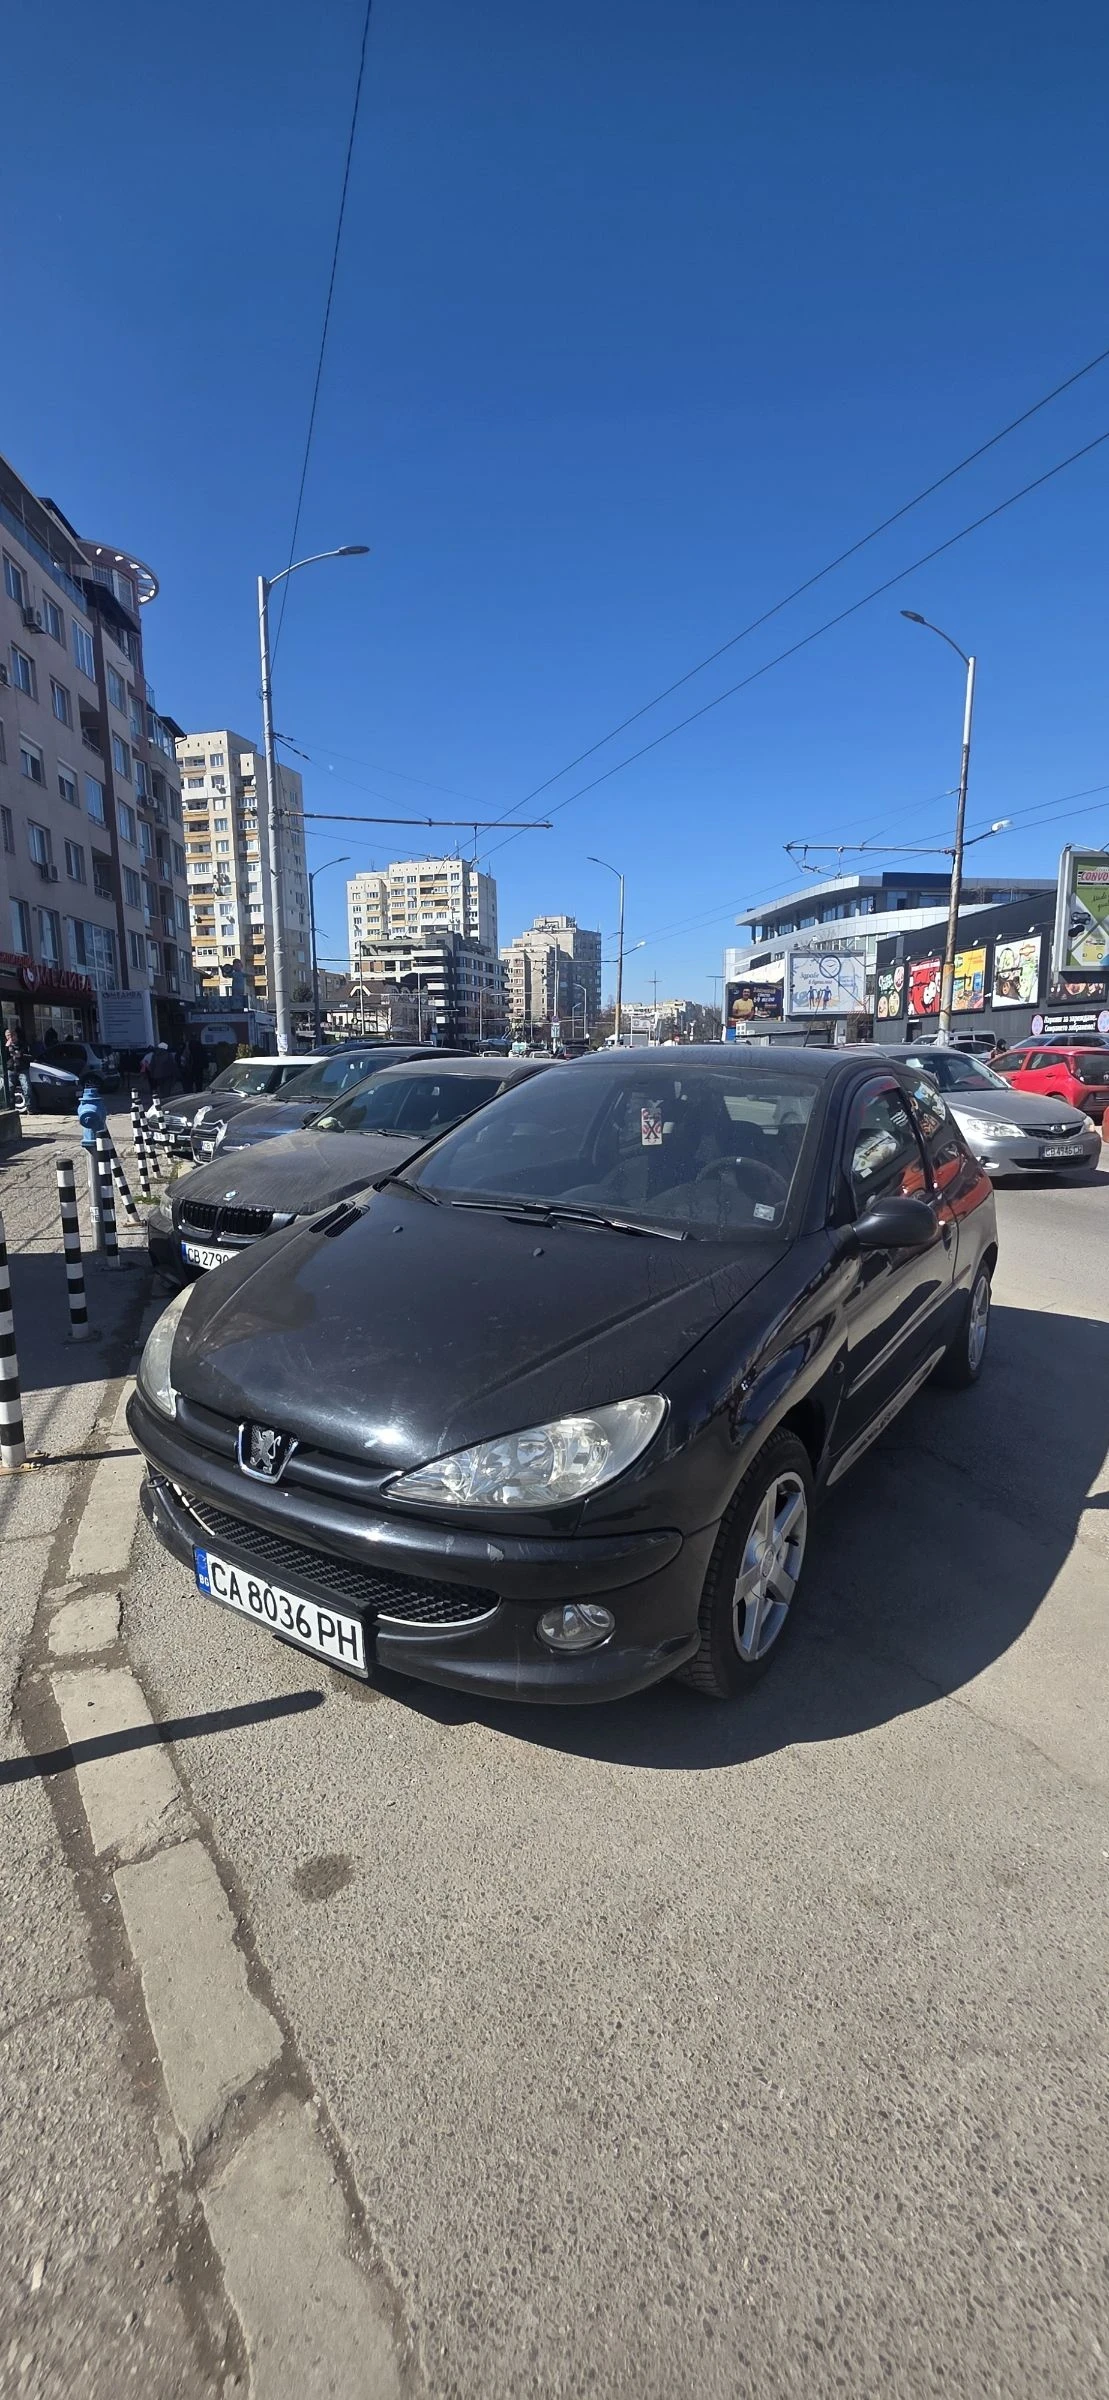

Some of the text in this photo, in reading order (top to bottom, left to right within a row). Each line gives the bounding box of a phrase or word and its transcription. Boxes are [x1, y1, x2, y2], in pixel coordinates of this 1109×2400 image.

[188, 1248, 200, 1264] CB
[199, 1573, 210, 1587] BG
[211, 1562, 359, 1661] CA 8036 PH
